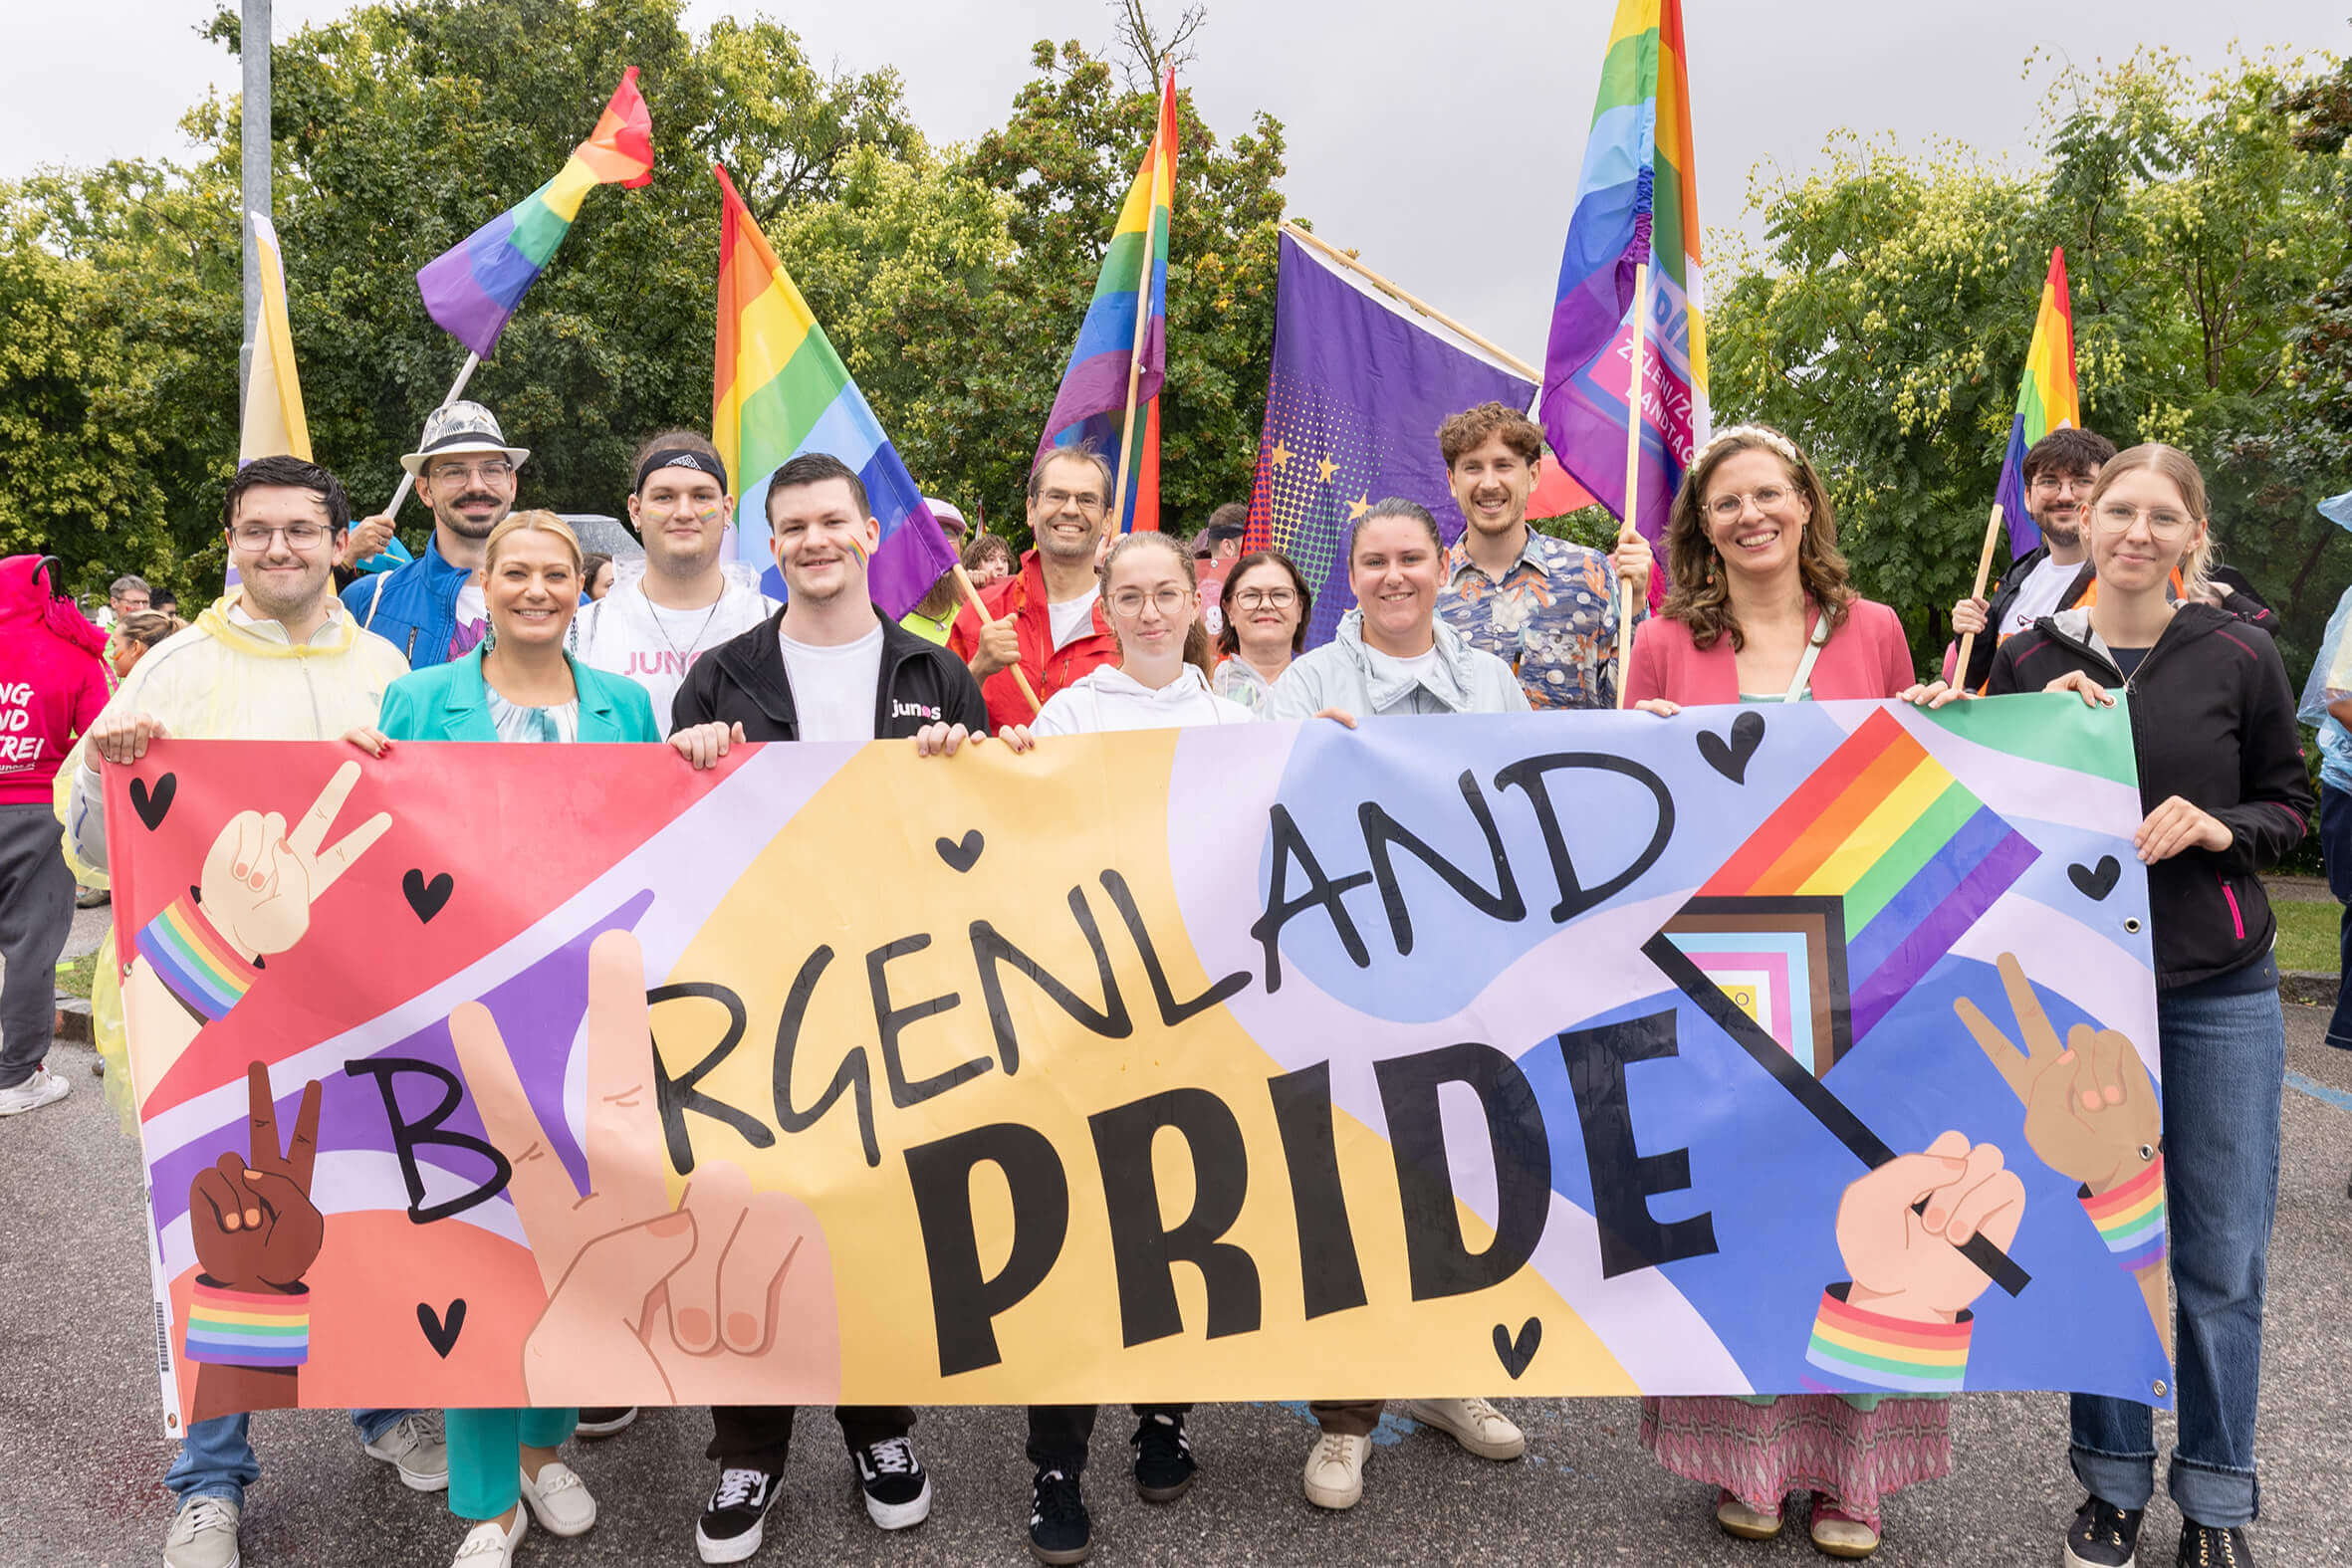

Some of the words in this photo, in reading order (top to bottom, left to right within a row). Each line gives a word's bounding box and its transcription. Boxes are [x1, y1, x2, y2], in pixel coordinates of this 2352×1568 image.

[1617, 337, 1696, 431] ZLENI/Z
[1625, 385, 1695, 466] ANDTAG
[0, 735, 45, 762] REI
[345, 751, 1675, 1225] BRGENLAND
[902, 1008, 1720, 1378] PRIDE
